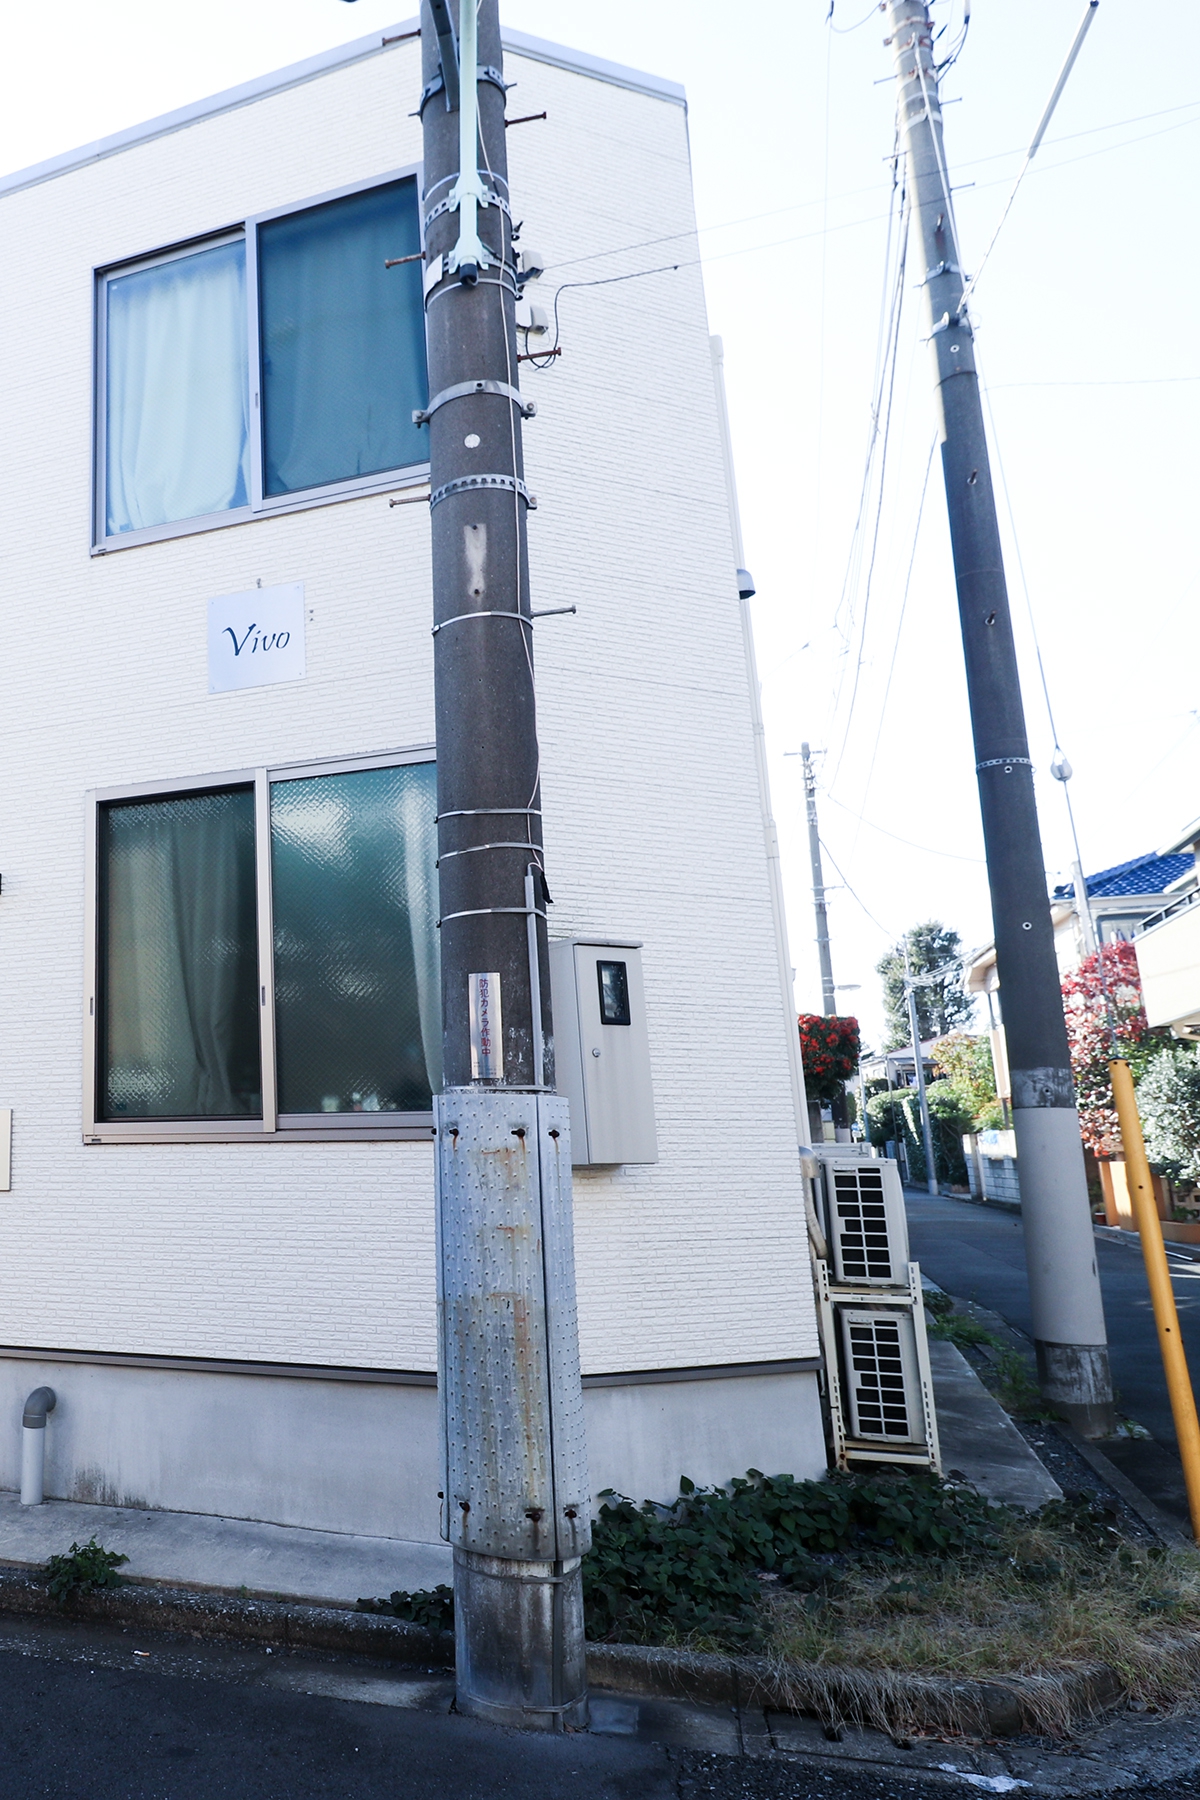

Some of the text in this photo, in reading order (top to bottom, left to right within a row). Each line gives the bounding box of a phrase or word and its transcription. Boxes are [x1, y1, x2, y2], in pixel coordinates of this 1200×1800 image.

[221, 623, 290, 656] Vivo
[479, 978, 491, 1057] 防犯カメラ作動中
